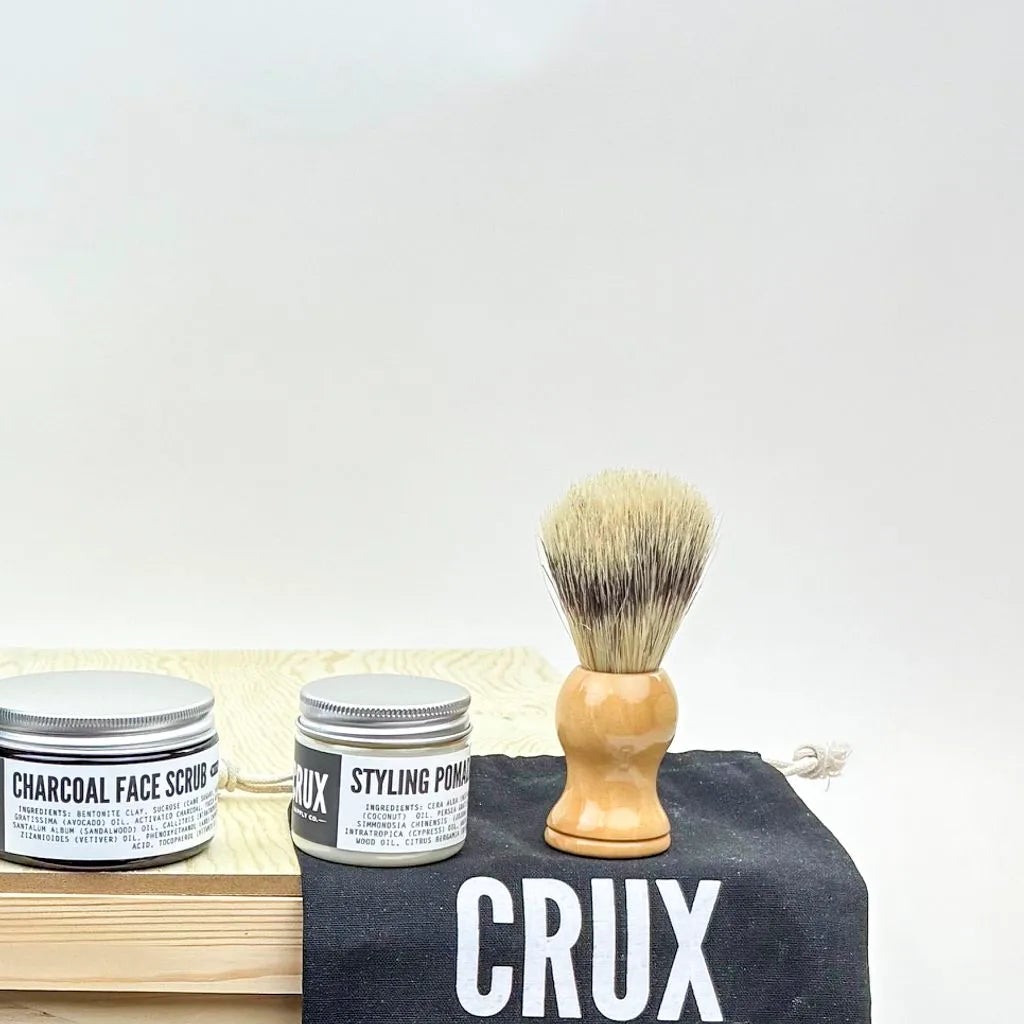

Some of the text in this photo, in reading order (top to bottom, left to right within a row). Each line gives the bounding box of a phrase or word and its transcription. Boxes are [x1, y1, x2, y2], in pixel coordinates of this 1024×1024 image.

[12, 771, 110, 804] CHARCOAL
[116, 773, 161, 803] FACE
[165, 762, 207, 797] SCRUB
[294, 761, 329, 814] RUX
[351, 767, 429, 795] STYLING
[18, 805, 71, 817] INGREDIENTS:
[77, 810, 120, 818] BENTONITE
[153, 802, 180, 814] SUCROSE
[366, 804, 423, 812] INGREDIENTS:
[427, 801, 443, 809] CERA
[14, 813, 58, 825] GRATISSIMA
[134, 812, 173, 824] ACTIVATED
[362, 812, 406, 820] (COCONUT)
[12, 822, 46, 832] SANTALUM
[51, 826, 74, 834] ALBUM
[79, 826, 136, 835] (SANDALWOOD)
[345, 827, 403, 838] INTRATROPICA
[20, 831, 69, 843] ZIZANIOIDES
[74, 836, 117, 844] (VETIVER)
[355, 838, 376, 846] WOOD
[405, 837, 431, 846] CITRUS
[455, 876, 724, 1022] CRUX
